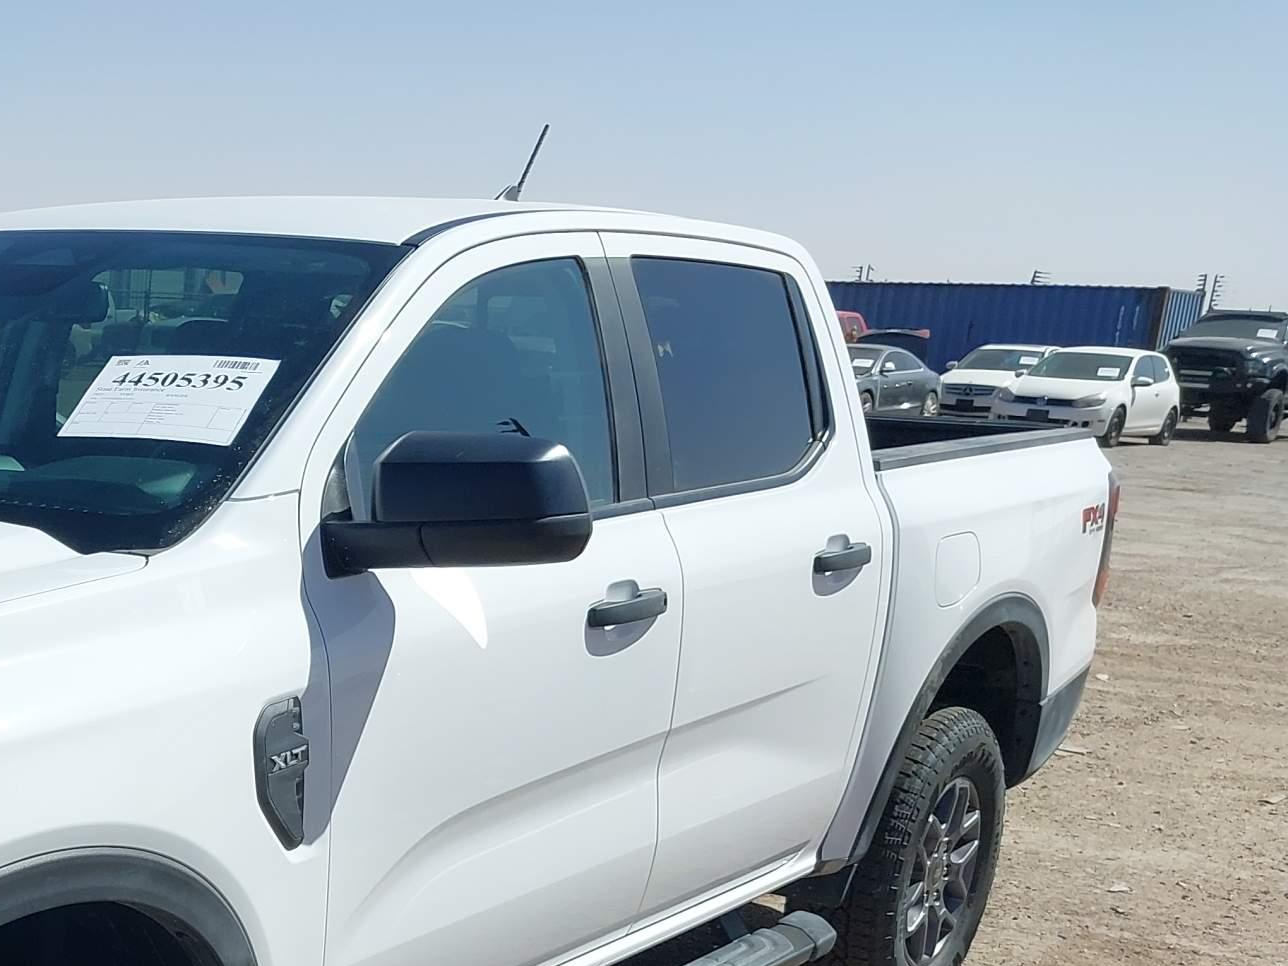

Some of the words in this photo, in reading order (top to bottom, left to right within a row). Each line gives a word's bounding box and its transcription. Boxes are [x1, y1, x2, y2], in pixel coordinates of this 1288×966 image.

[112, 371, 249, 391] 44505395
[1082, 502, 1105, 534] FX4
[270, 744, 308, 772] XLT
